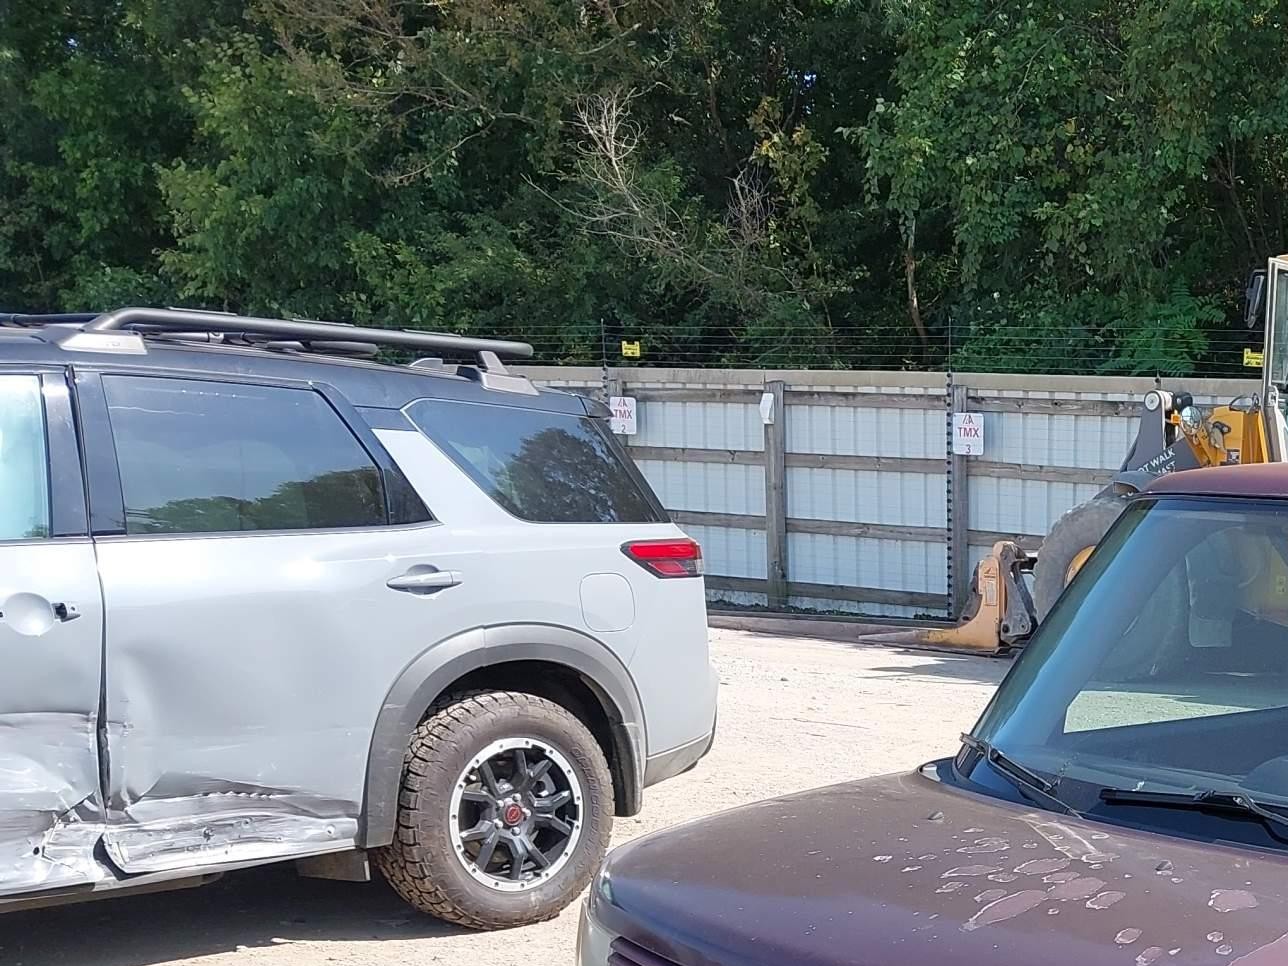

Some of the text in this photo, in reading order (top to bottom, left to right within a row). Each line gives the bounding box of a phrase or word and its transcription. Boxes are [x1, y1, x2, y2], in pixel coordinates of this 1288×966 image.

[613, 409, 633, 419] TMX
[621, 424, 626, 433] 2
[957, 427, 979, 438] TMX
[966, 444, 971, 454] 3
[1150, 448, 1175, 467] WALK
